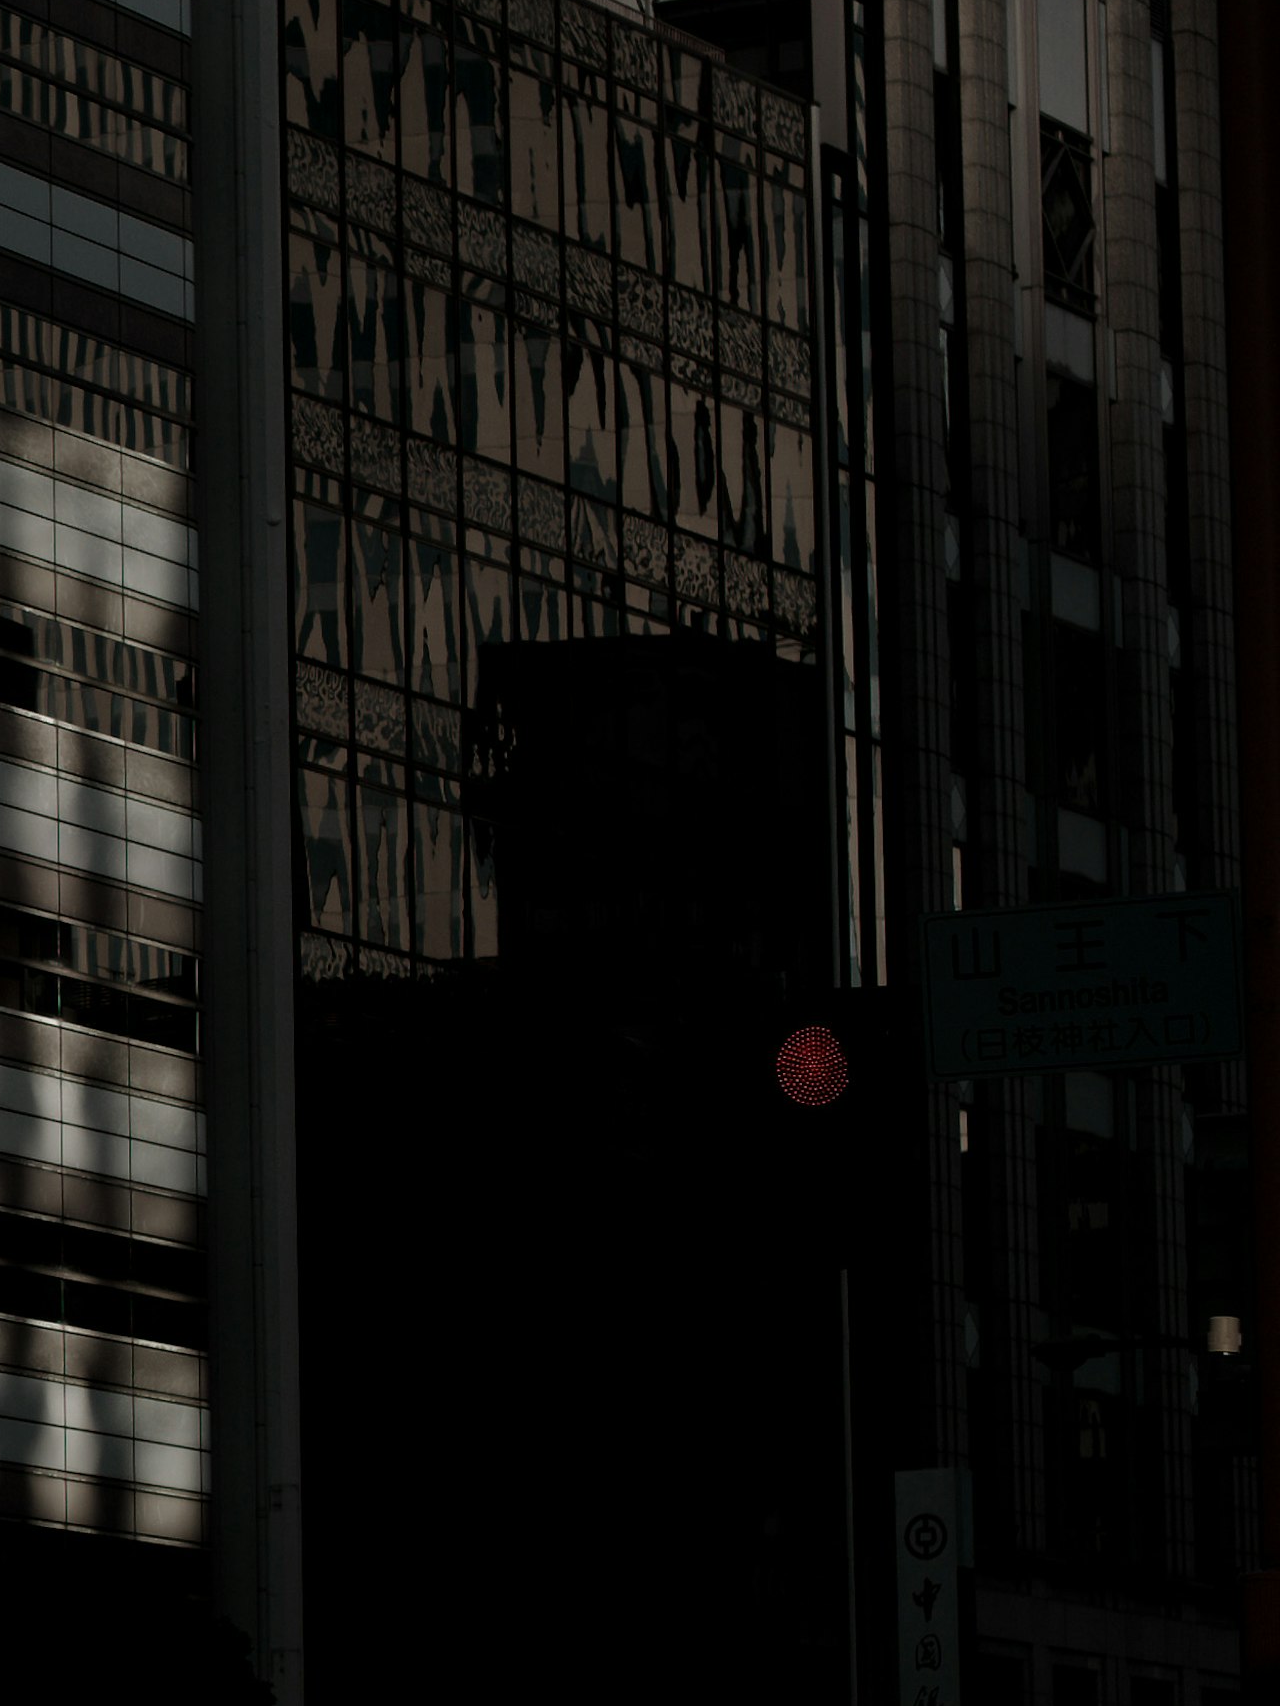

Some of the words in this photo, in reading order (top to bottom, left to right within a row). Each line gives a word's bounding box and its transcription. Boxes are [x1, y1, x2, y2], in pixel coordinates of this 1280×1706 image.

[952, 908, 1211, 981] 山王下
[997, 975, 1169, 1016] Sannoshita
